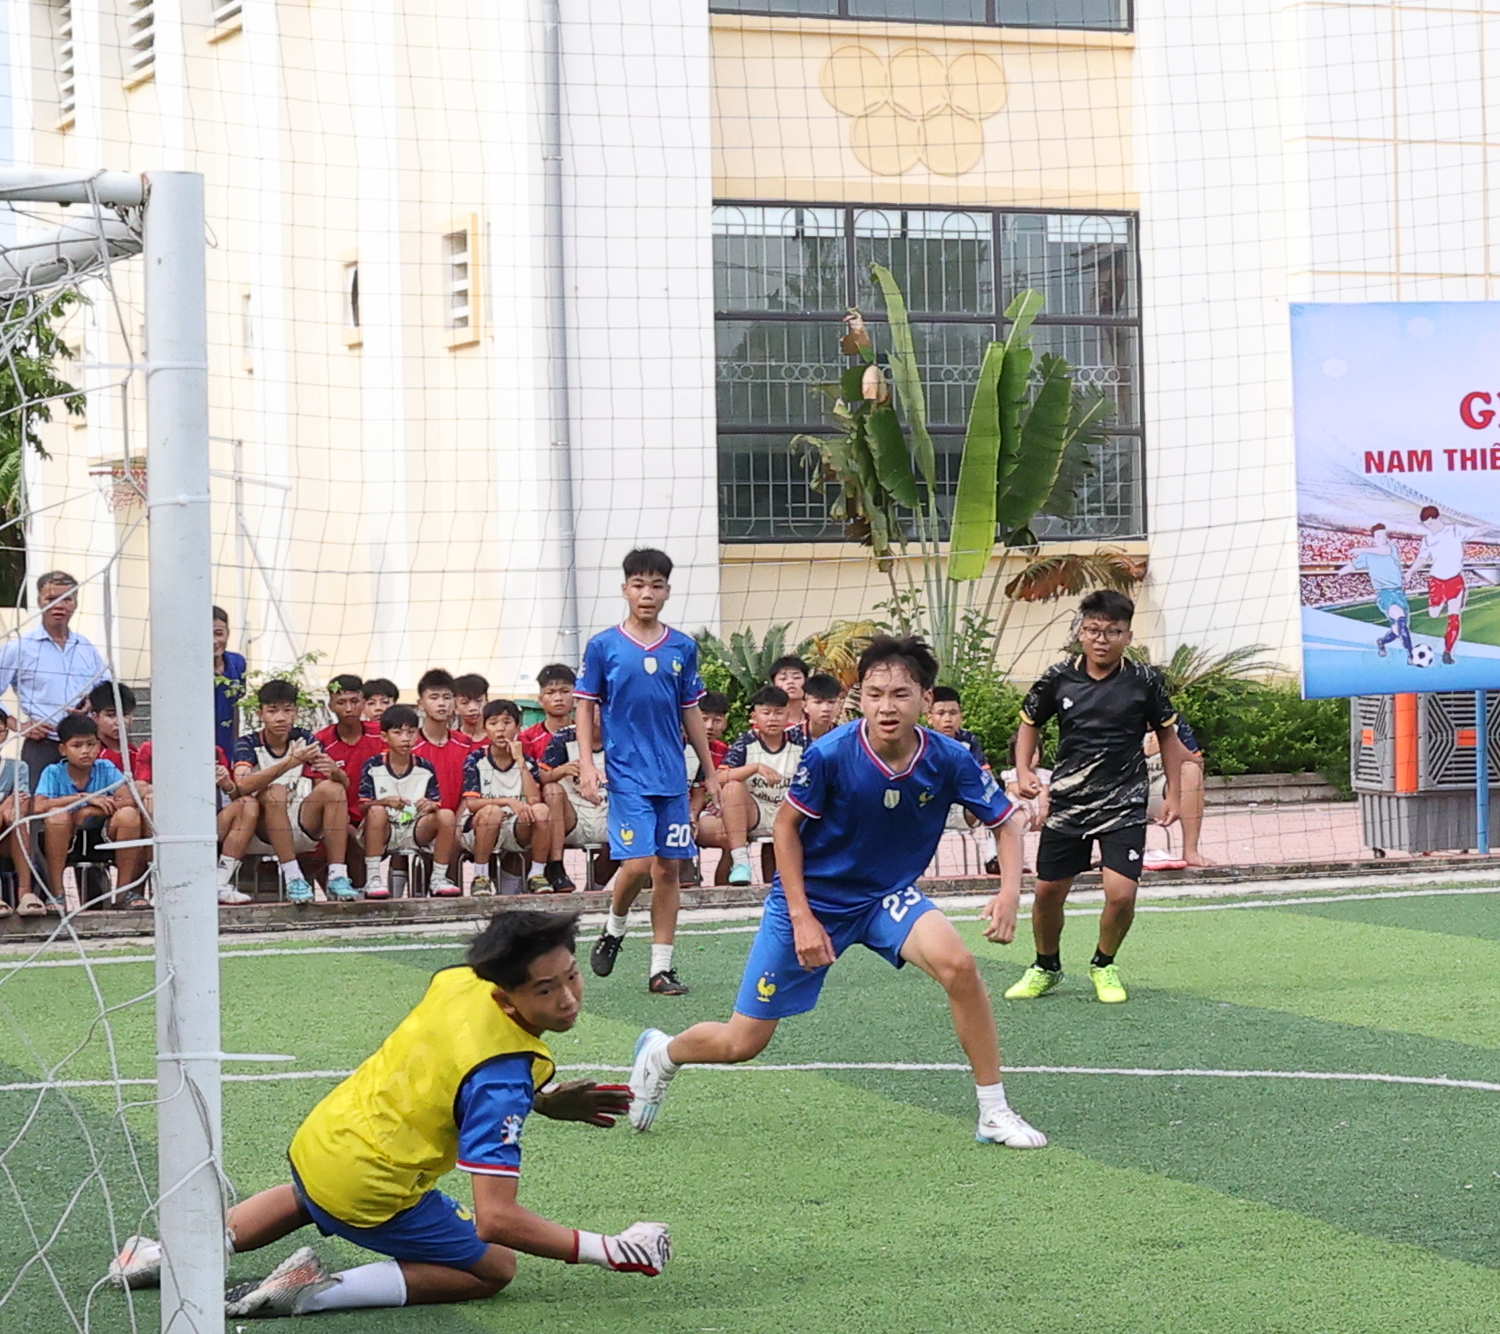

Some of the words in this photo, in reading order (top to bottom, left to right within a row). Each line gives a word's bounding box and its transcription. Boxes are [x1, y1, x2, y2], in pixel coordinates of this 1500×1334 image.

[1364, 449, 1433, 474] NAM
[666, 823, 691, 848] 20
[882, 885, 923, 923] 23
